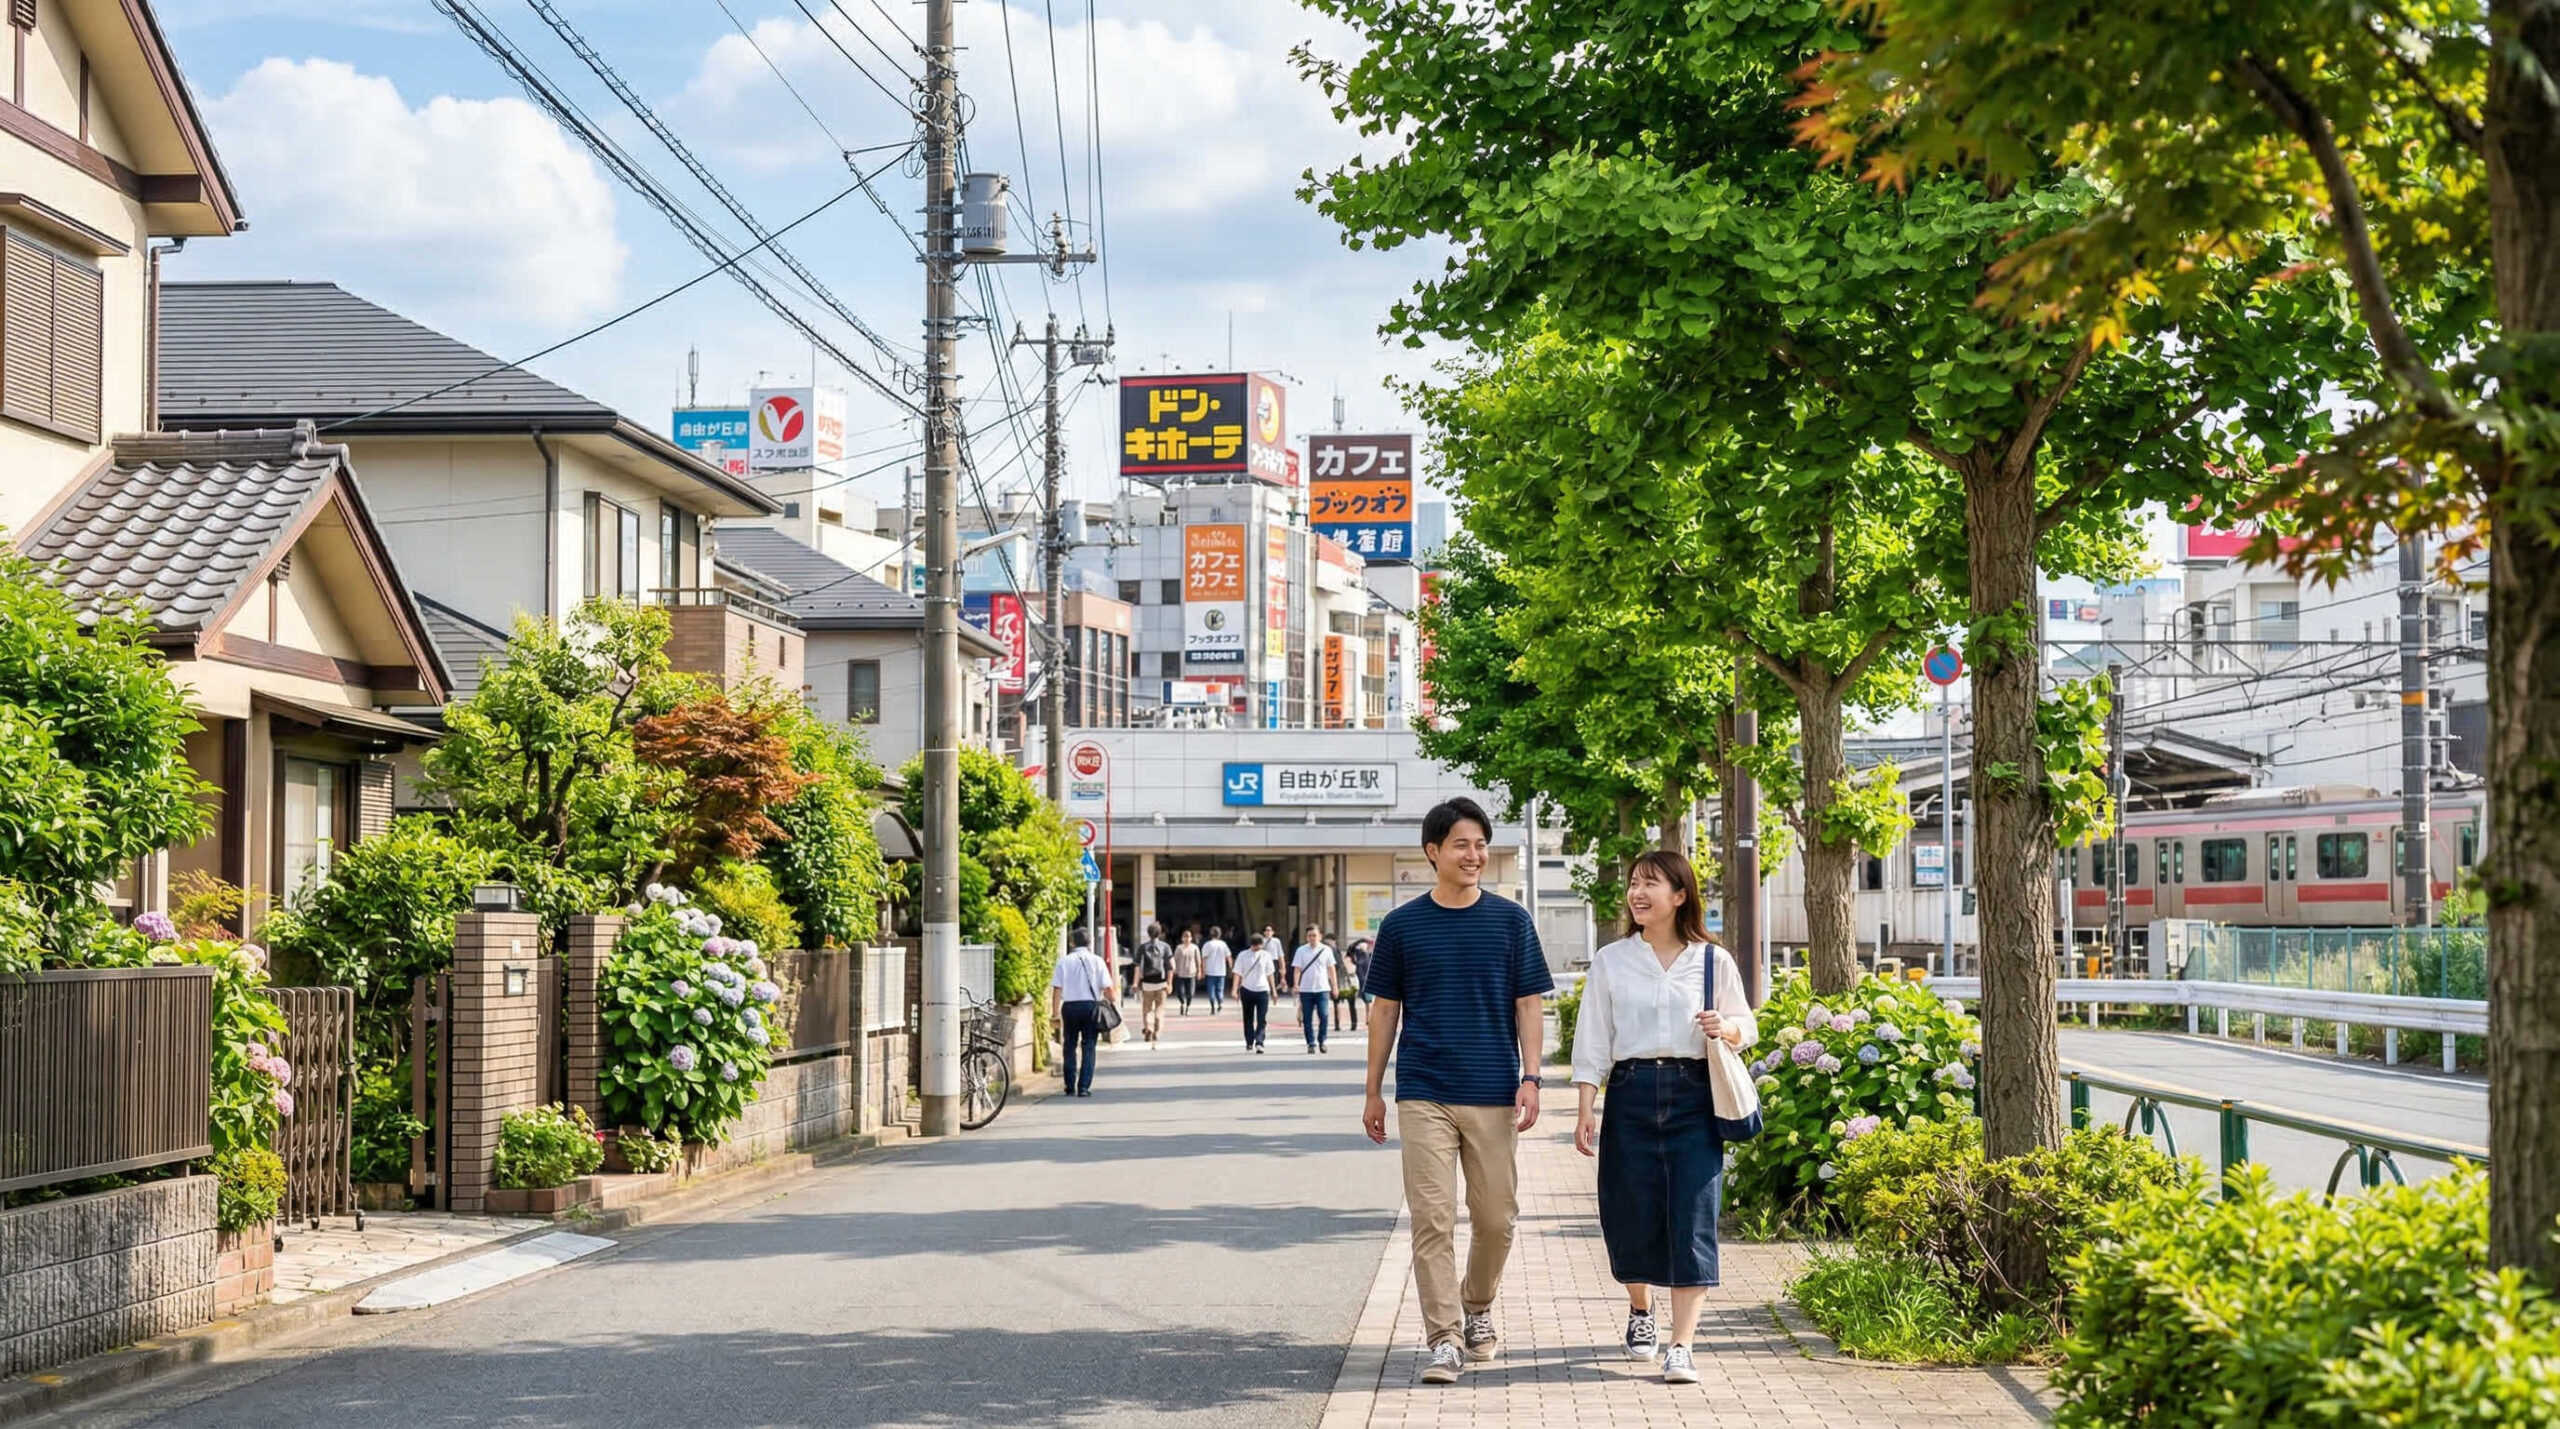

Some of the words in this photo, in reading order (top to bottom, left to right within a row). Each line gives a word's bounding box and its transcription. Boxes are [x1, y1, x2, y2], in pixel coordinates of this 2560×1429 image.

[1149, 388, 1221, 423] ドン・
[1125, 425, 1242, 461] キホーテ
[1316, 444, 1406, 476] カフェ
[1190, 551, 1240, 569] カフェ
[1190, 571, 1238, 588] カフェ
[1228, 773, 1259, 791] JR
[1279, 768, 1380, 789] 自由が丘駅
